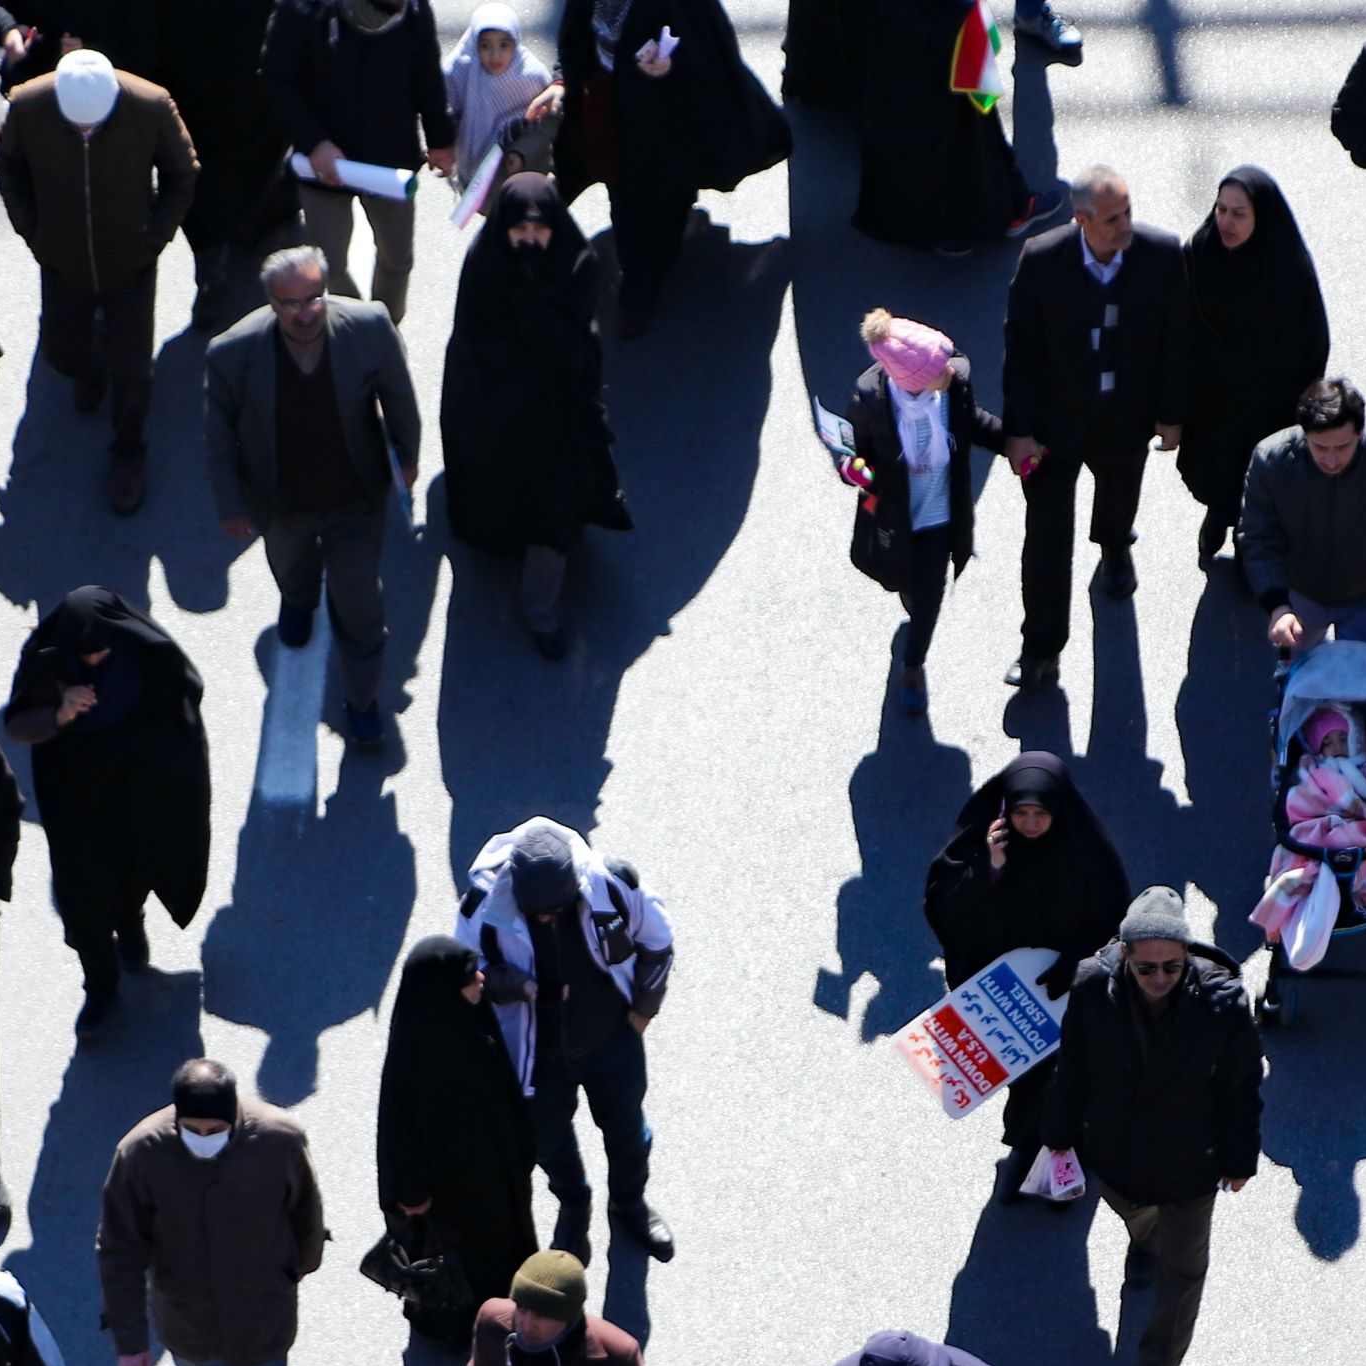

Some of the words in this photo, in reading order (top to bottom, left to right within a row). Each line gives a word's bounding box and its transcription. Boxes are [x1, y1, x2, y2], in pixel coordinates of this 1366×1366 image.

[960, 990, 984, 1016] مرگ
[980, 1012, 999, 1024] بر
[980, 975, 1013, 1013] WITH
[1009, 982, 1048, 1026] ISRAEL
[924, 1017, 958, 1055] WITH
[957, 1028, 989, 1064] U.S.A
[1008, 1008, 1048, 1051] DOWN
[954, 1050, 993, 1093] DOWN
